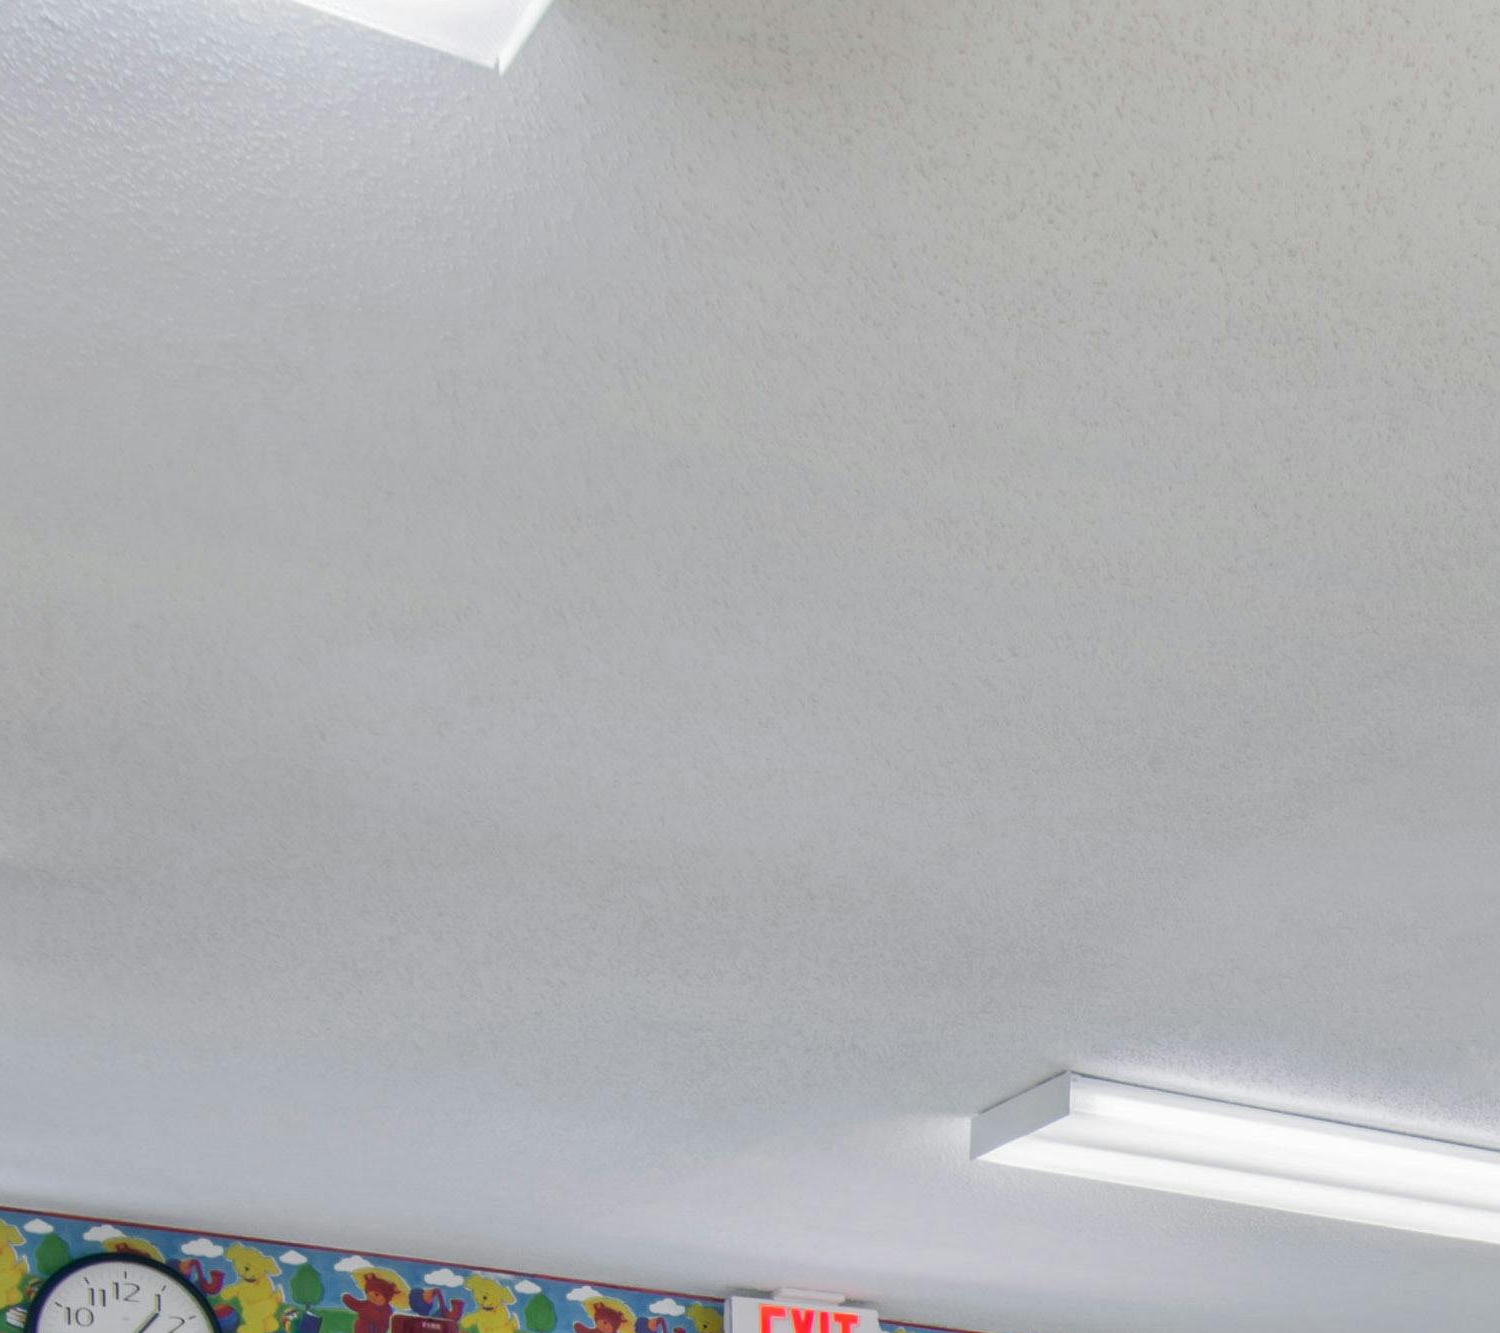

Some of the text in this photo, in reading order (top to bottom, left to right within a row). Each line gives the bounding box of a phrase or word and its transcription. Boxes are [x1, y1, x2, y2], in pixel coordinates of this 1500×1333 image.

[88, 1287, 106, 1307] 11
[112, 1281, 140, 1303] 12
[155, 1293, 162, 1312] 1
[64, 1306, 95, 1327] 10
